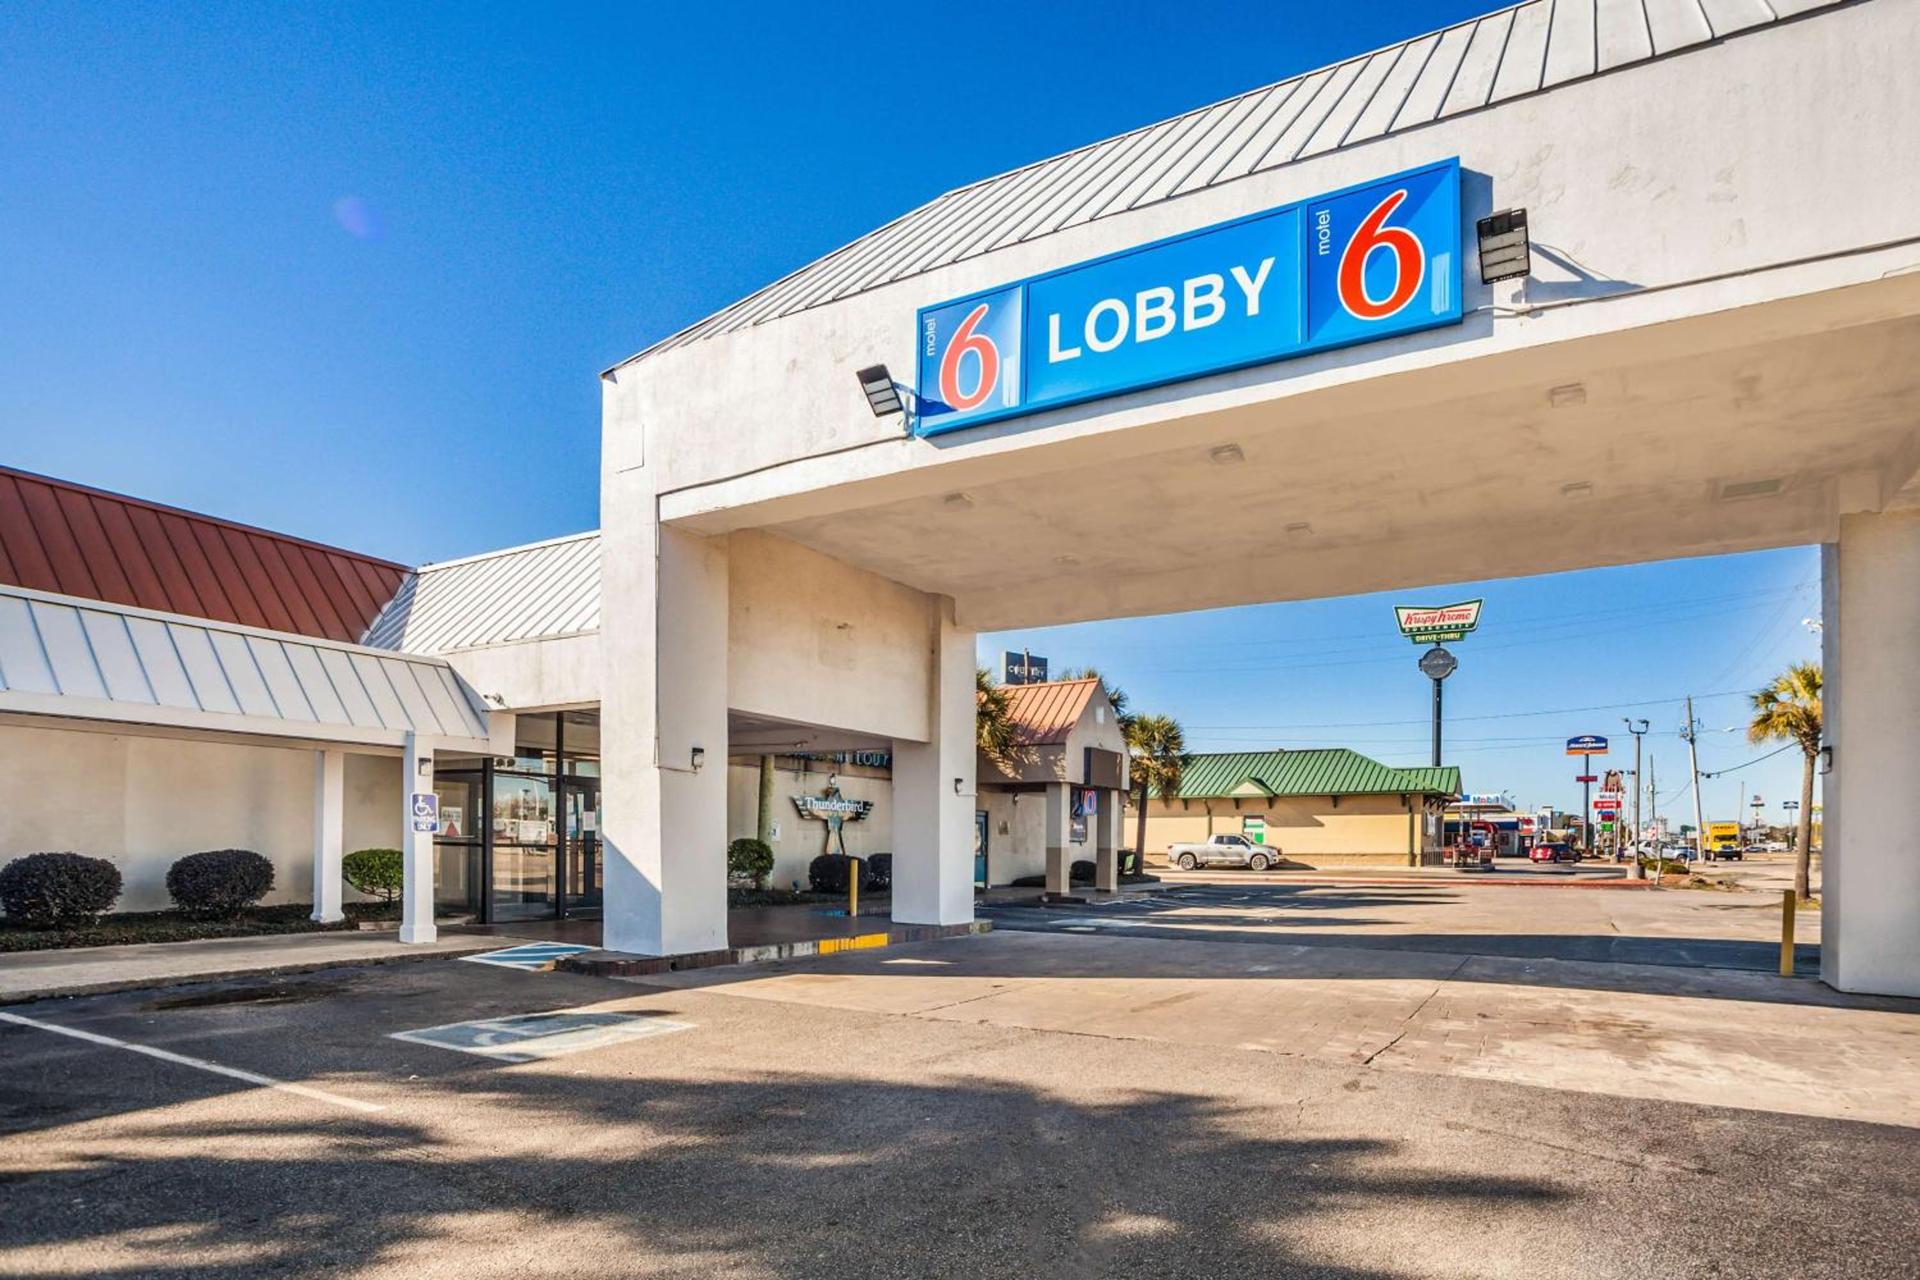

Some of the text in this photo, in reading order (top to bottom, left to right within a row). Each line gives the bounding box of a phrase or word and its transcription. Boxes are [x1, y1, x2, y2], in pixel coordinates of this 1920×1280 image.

[1317, 209, 1330, 256] motel
[1337, 188, 1425, 322] 6
[1048, 256, 1277, 363] LOBBY
[925, 318, 936, 358] motel
[938, 303, 1000, 412] 6
[1404, 608, 1472, 624] Krispy Kreme
[805, 797, 864, 812] Thunderbird
[1473, 796, 1499, 804] Mobil
